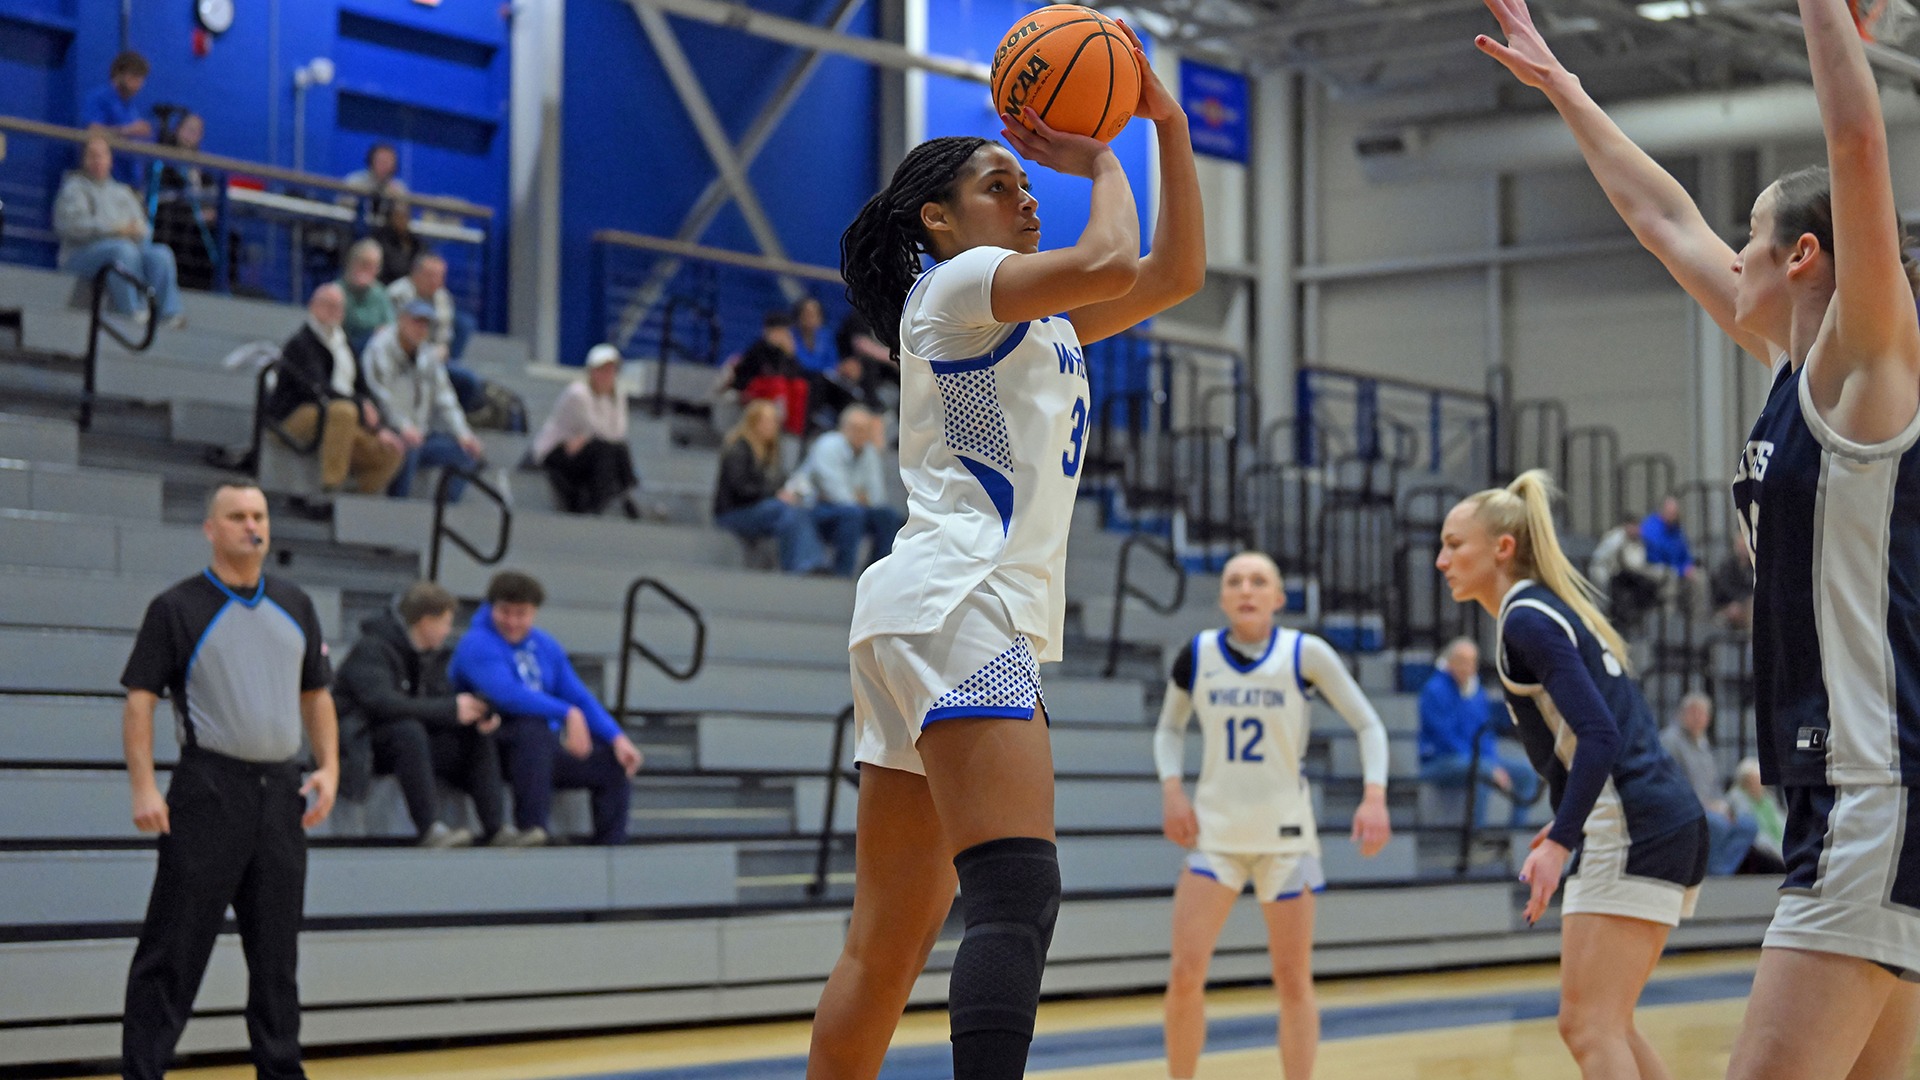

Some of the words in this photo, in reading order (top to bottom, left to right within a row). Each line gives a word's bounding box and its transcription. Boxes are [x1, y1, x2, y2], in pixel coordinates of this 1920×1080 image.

[1005, 53, 1050, 116] NCAA
[1041, 67, 1056, 85] BALL
[1208, 688, 1286, 708] WHEATON
[1225, 717, 1265, 762] 12
[1812, 732, 1819, 745] L
